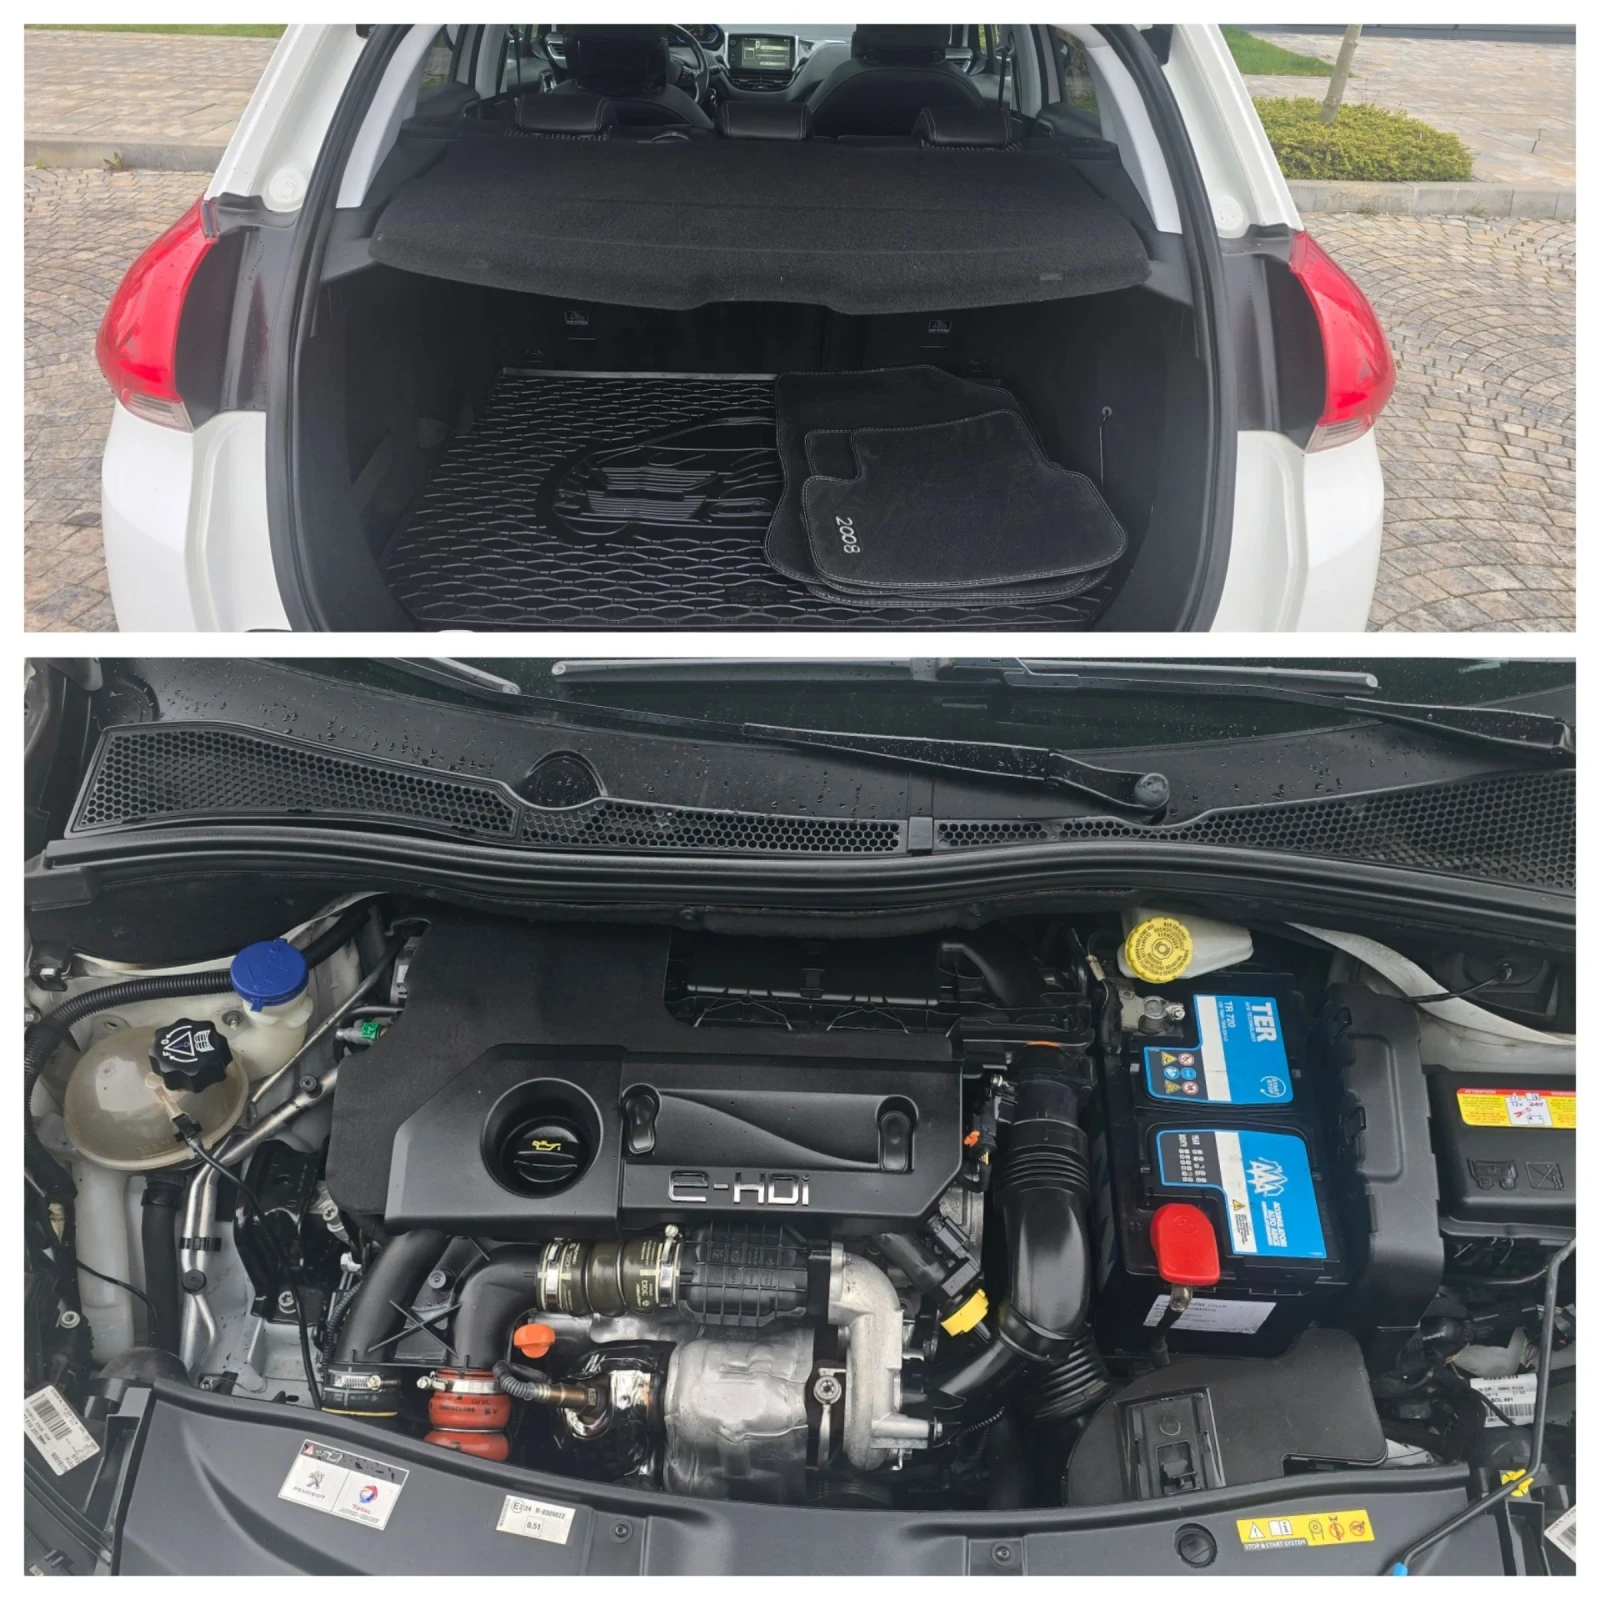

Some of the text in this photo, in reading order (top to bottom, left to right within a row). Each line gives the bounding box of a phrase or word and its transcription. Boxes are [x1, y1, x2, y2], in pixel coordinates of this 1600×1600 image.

[836, 516, 860, 554] 2008
[1224, 1001, 1236, 1028] TR 720
[1252, 1002, 1278, 1042] TER
[294, 1486, 326, 1499] PEUGEOT
[352, 1504, 372, 1514] TOTAL
[527, 1522, 541, 1530] 0.51
